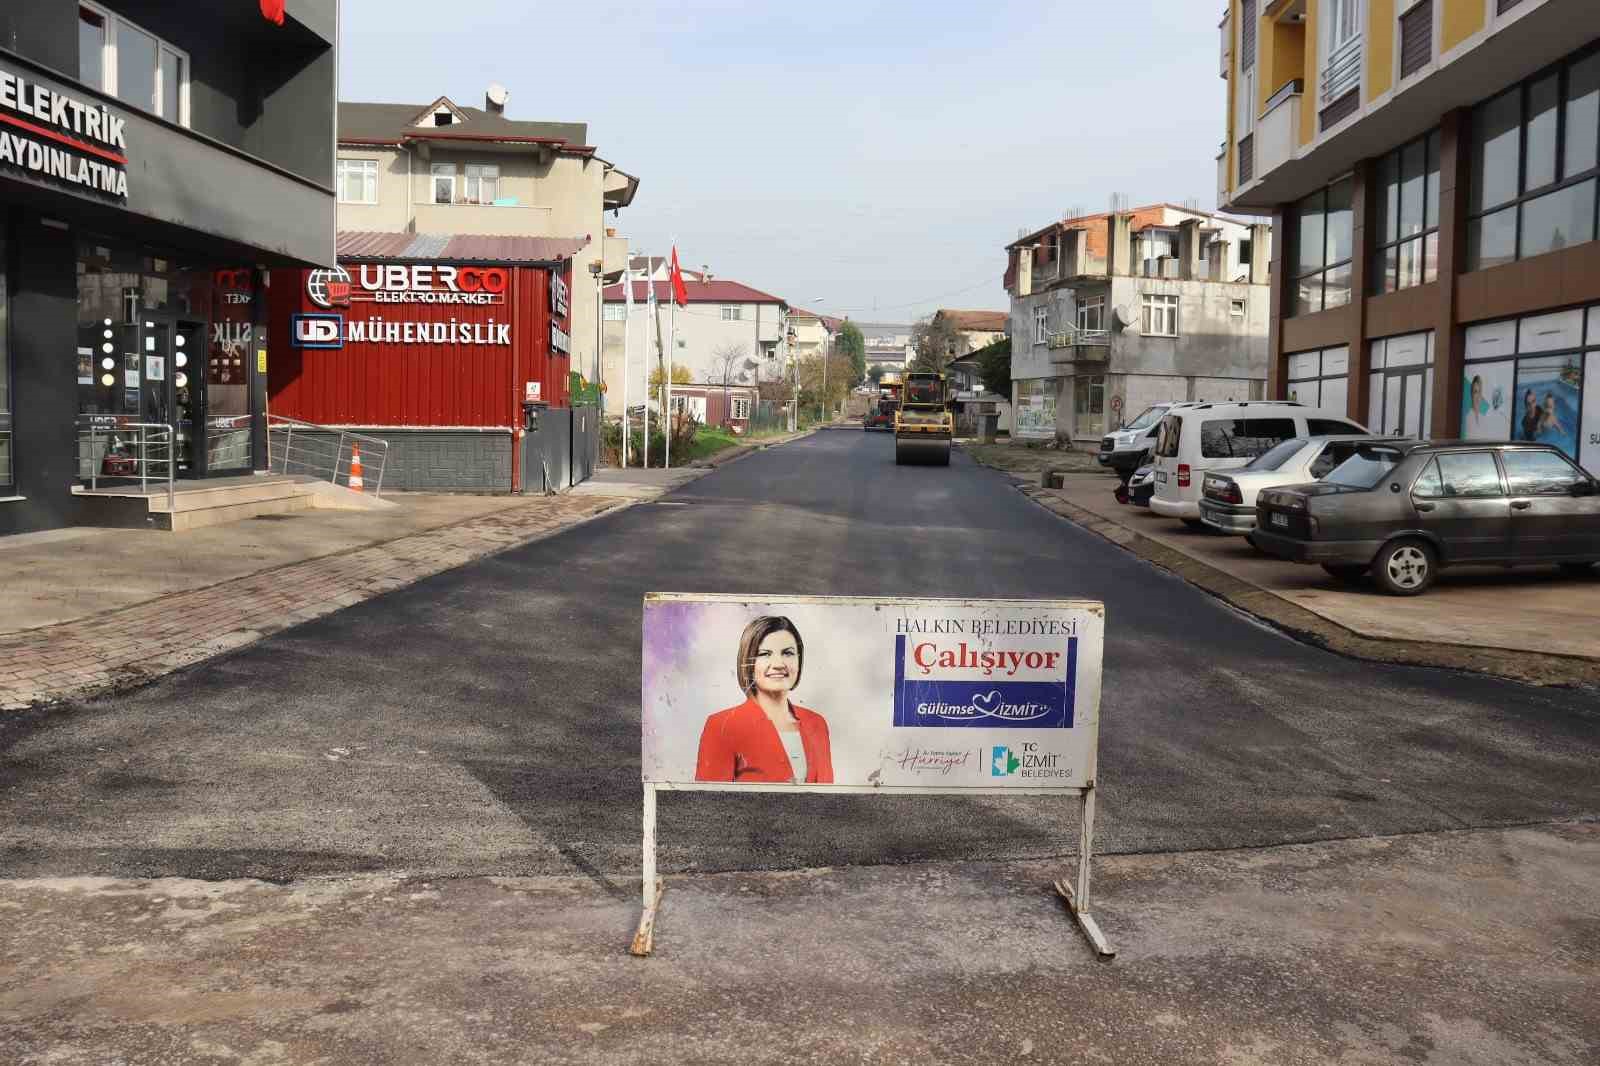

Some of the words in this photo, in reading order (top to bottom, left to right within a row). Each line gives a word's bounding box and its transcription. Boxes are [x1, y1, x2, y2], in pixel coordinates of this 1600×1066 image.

[0, 70, 127, 149] ELEKTRİK
[0, 131, 128, 197] AYDINLATMA
[360, 264, 508, 292] UBERCO
[375, 291, 436, 304] ELEKTRO
[438, 293, 494, 305] MARKET
[349, 316, 511, 344] MÜHENDİSLİK
[897, 618, 964, 633] HALKIN
[971, 617, 1077, 635] BELEDİYESİ
[914, 642, 1060, 675] Çalışıyor
[917, 702, 975, 715] Gülümse
[1022, 752, 1057, 768] İZMİT
